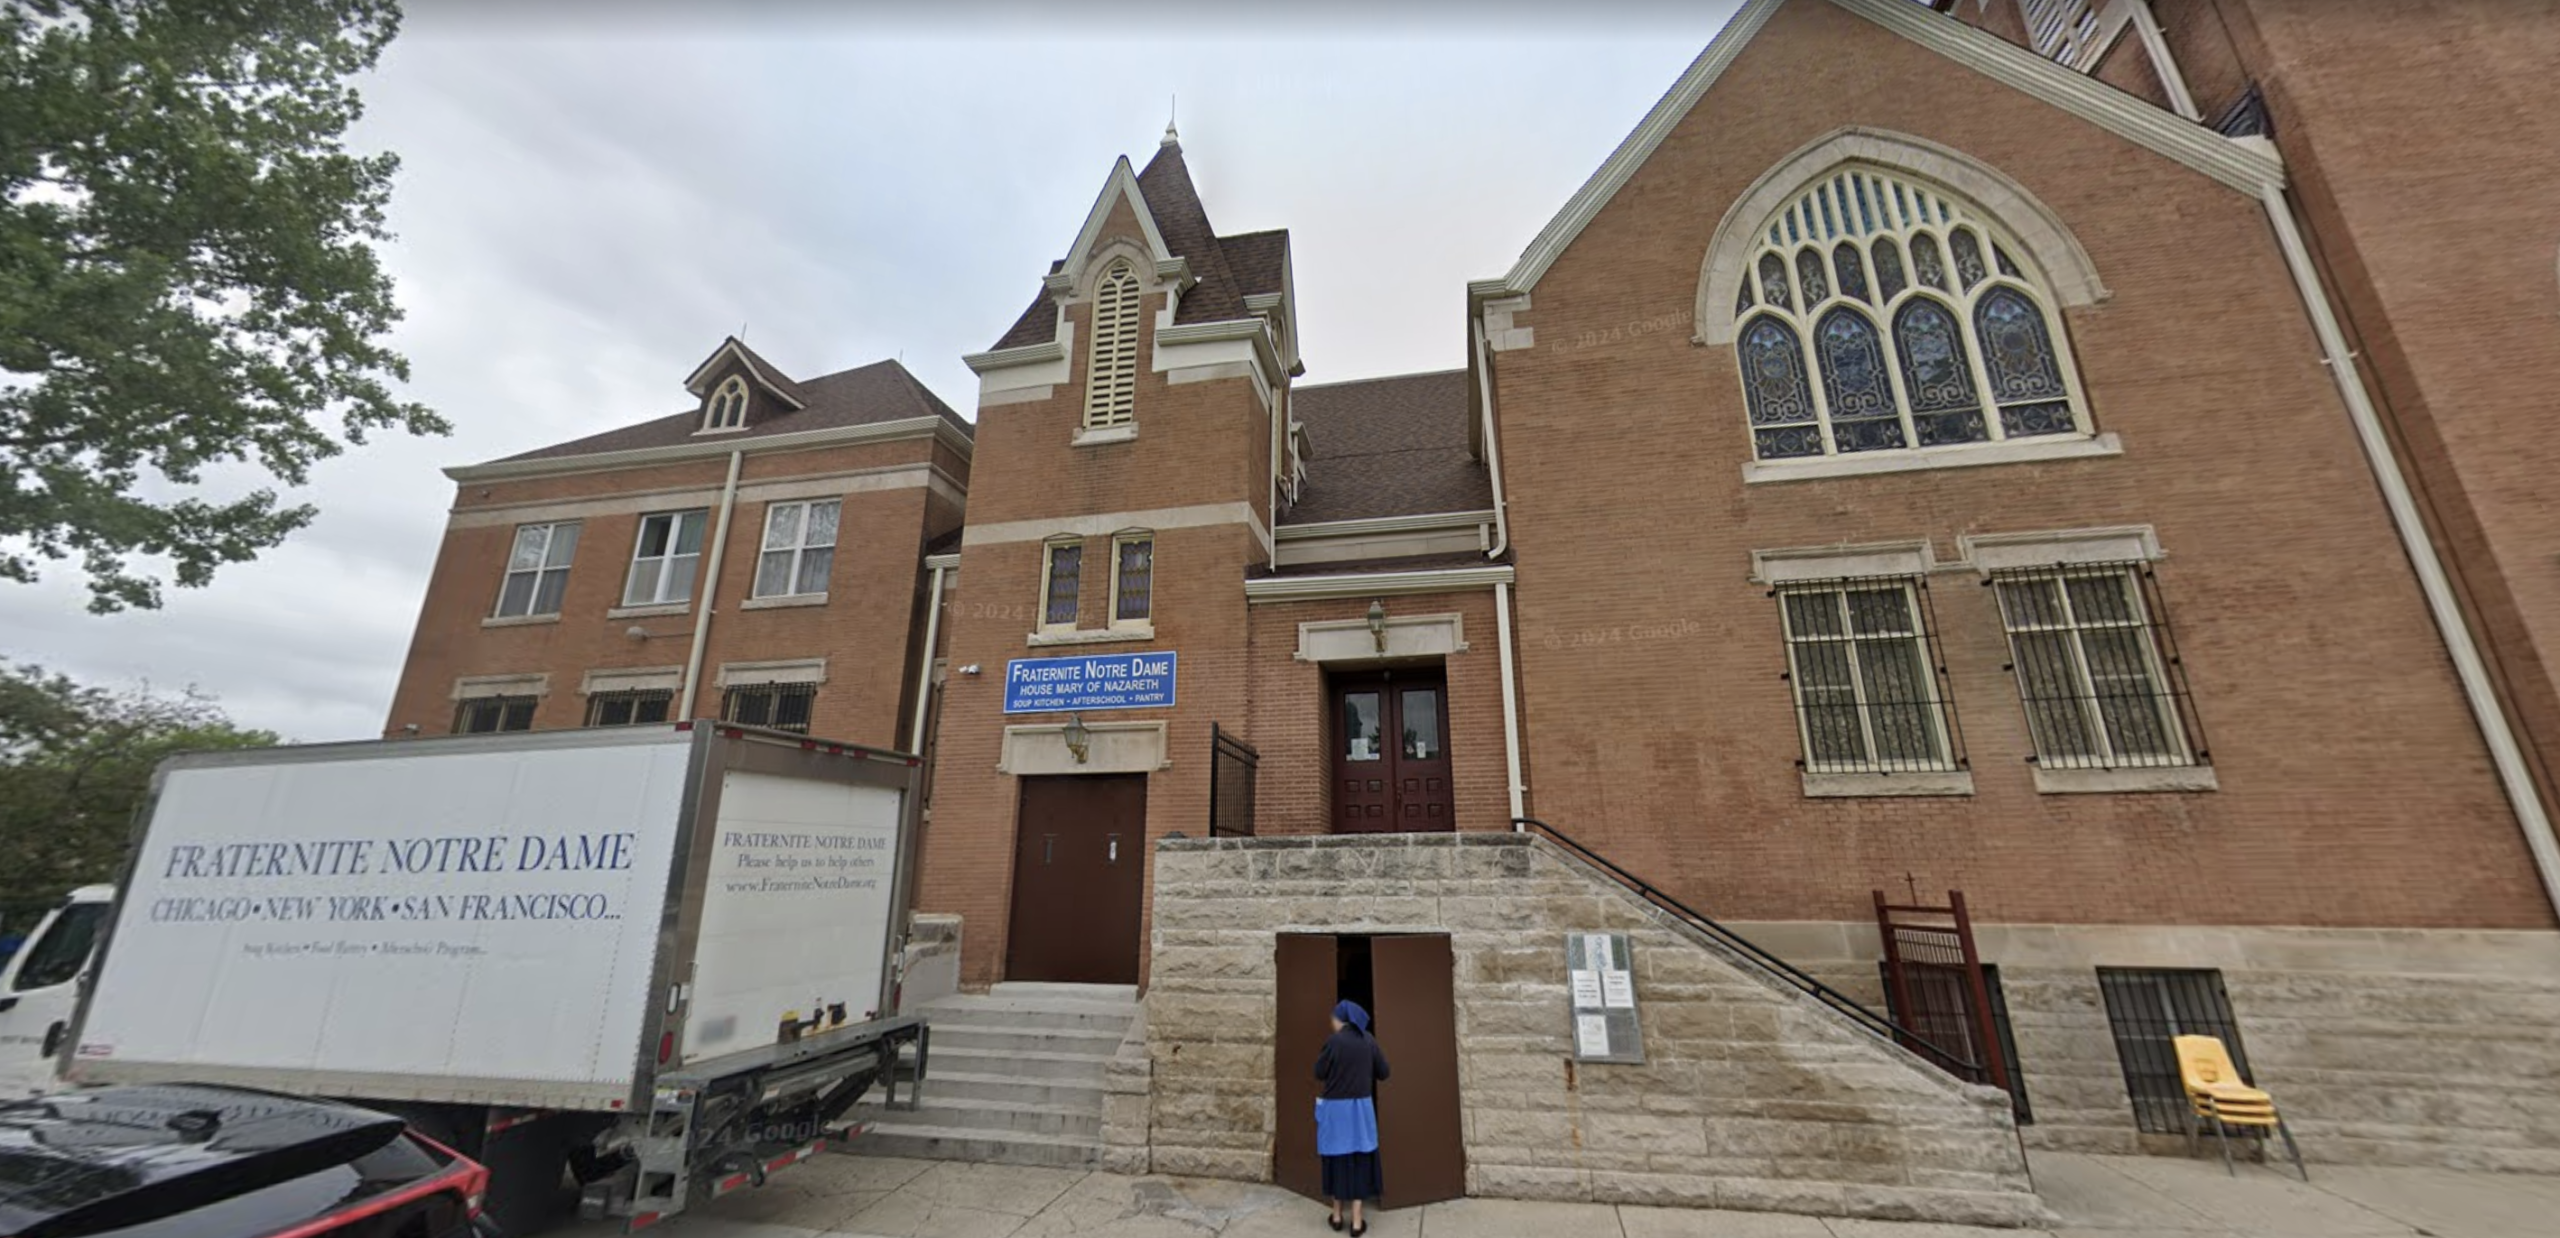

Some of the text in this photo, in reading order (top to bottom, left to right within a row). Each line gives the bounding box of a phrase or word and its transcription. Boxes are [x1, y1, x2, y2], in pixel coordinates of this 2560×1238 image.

[1012, 658, 1169, 683] FRATERNITE NOTRE DAME
[1020, 679, 1159, 696] HOUSE MARY OF NAZARETH
[1013, 693, 1164, 708] SOUP KITCHEN AFTERSCHOOL PANTRY
[723, 831, 887, 850] FRATERNITE NOTRE DAME
[164, 832, 636, 878] FRATERNITE NOTRE DAME
[737, 854, 875, 871] Please help us to help others
